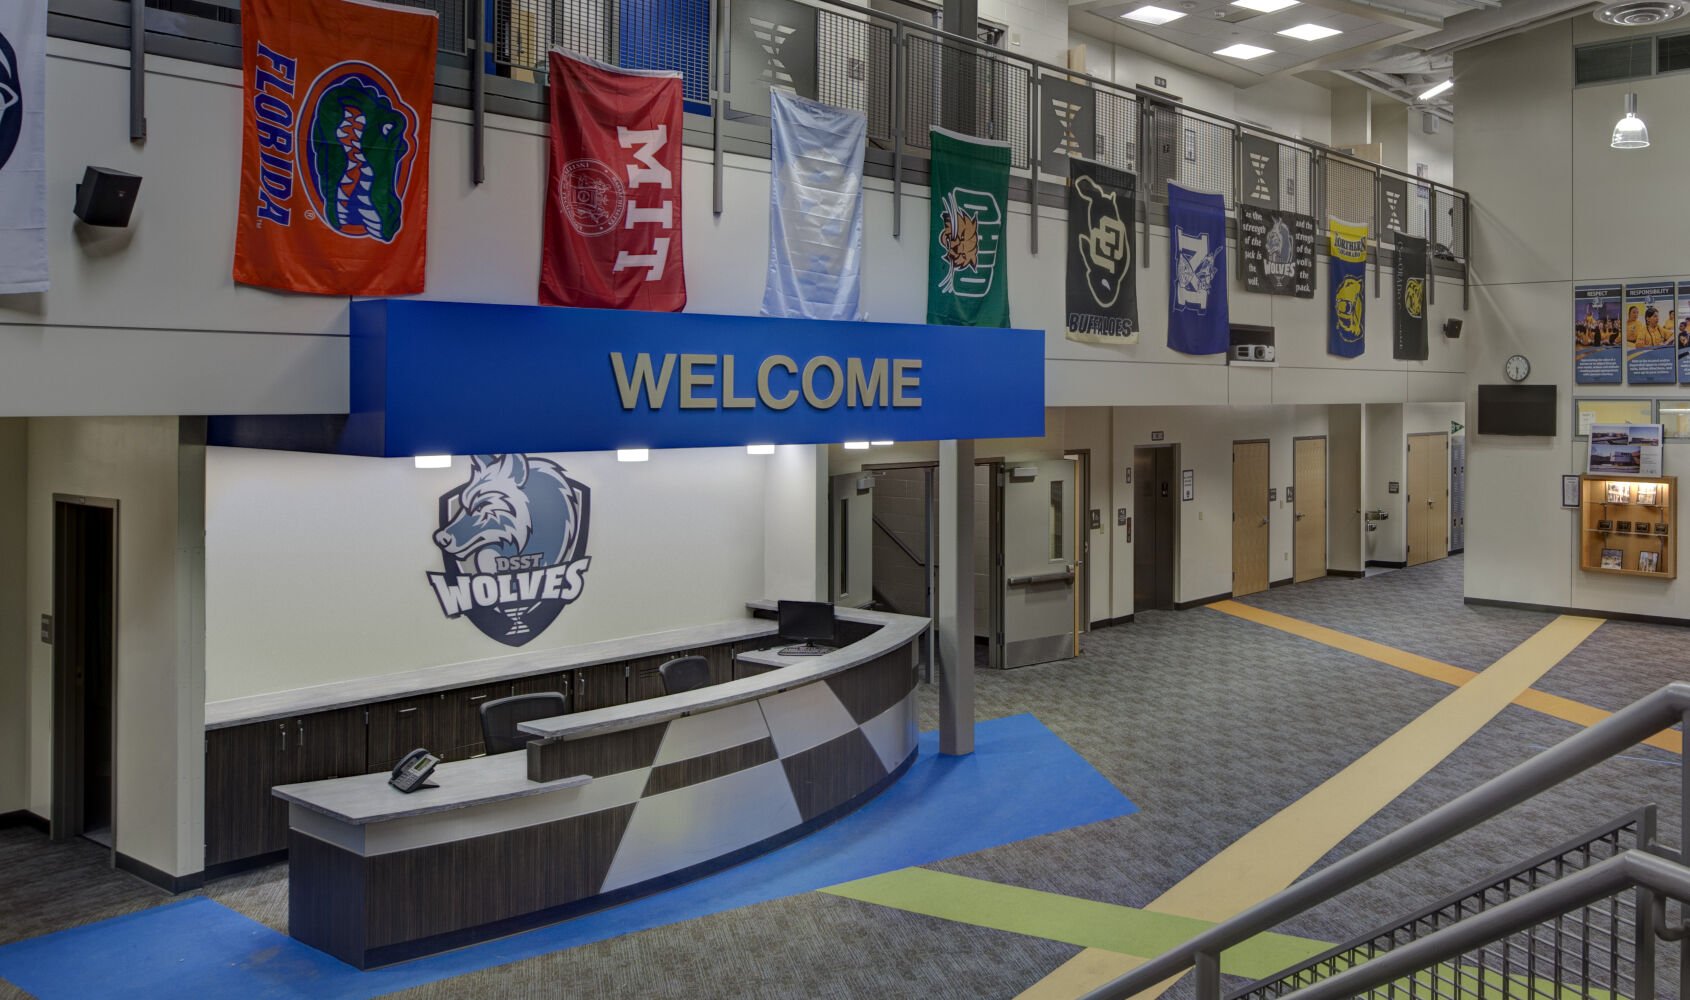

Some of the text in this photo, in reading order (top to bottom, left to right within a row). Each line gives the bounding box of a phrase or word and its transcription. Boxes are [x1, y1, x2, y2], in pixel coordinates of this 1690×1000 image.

[254, 40, 297, 226] FLORIDA
[613, 124, 673, 281] MIT
[1263, 259, 1296, 278] WOLVES
[1629, 288, 1669, 296] RESPONSIBILITY
[1069, 313, 1133, 337] BUFFALOES
[610, 351, 923, 410] WELCOME
[495, 552, 544, 571] DSST
[427, 556, 592, 618] WOLVES
